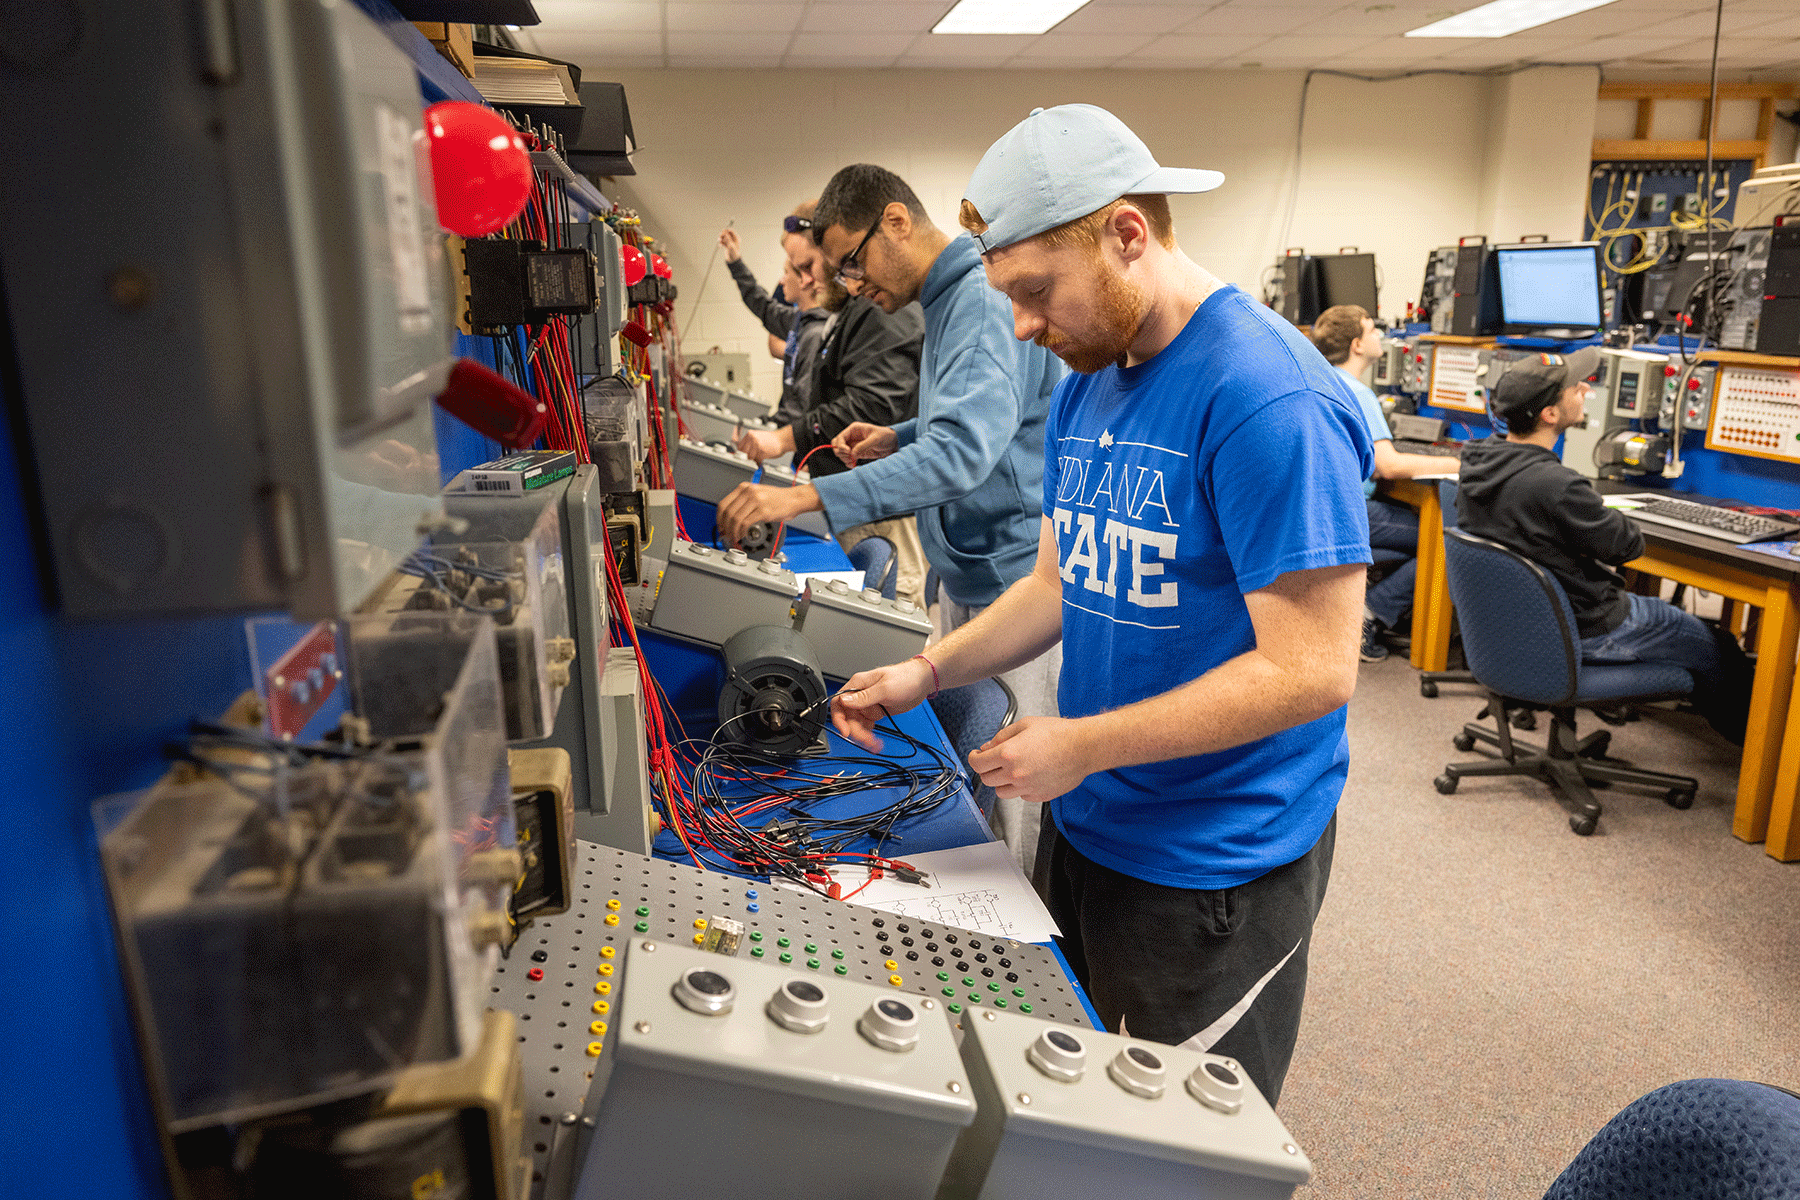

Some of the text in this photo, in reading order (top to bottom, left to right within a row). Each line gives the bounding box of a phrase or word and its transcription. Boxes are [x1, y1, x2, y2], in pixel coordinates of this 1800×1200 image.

[525, 472, 555, 490] Miniature
[554, 465, 573, 480] Lamps
[1057, 456, 1180, 527] NDIANA
[1052, 507, 1179, 608] TATE
